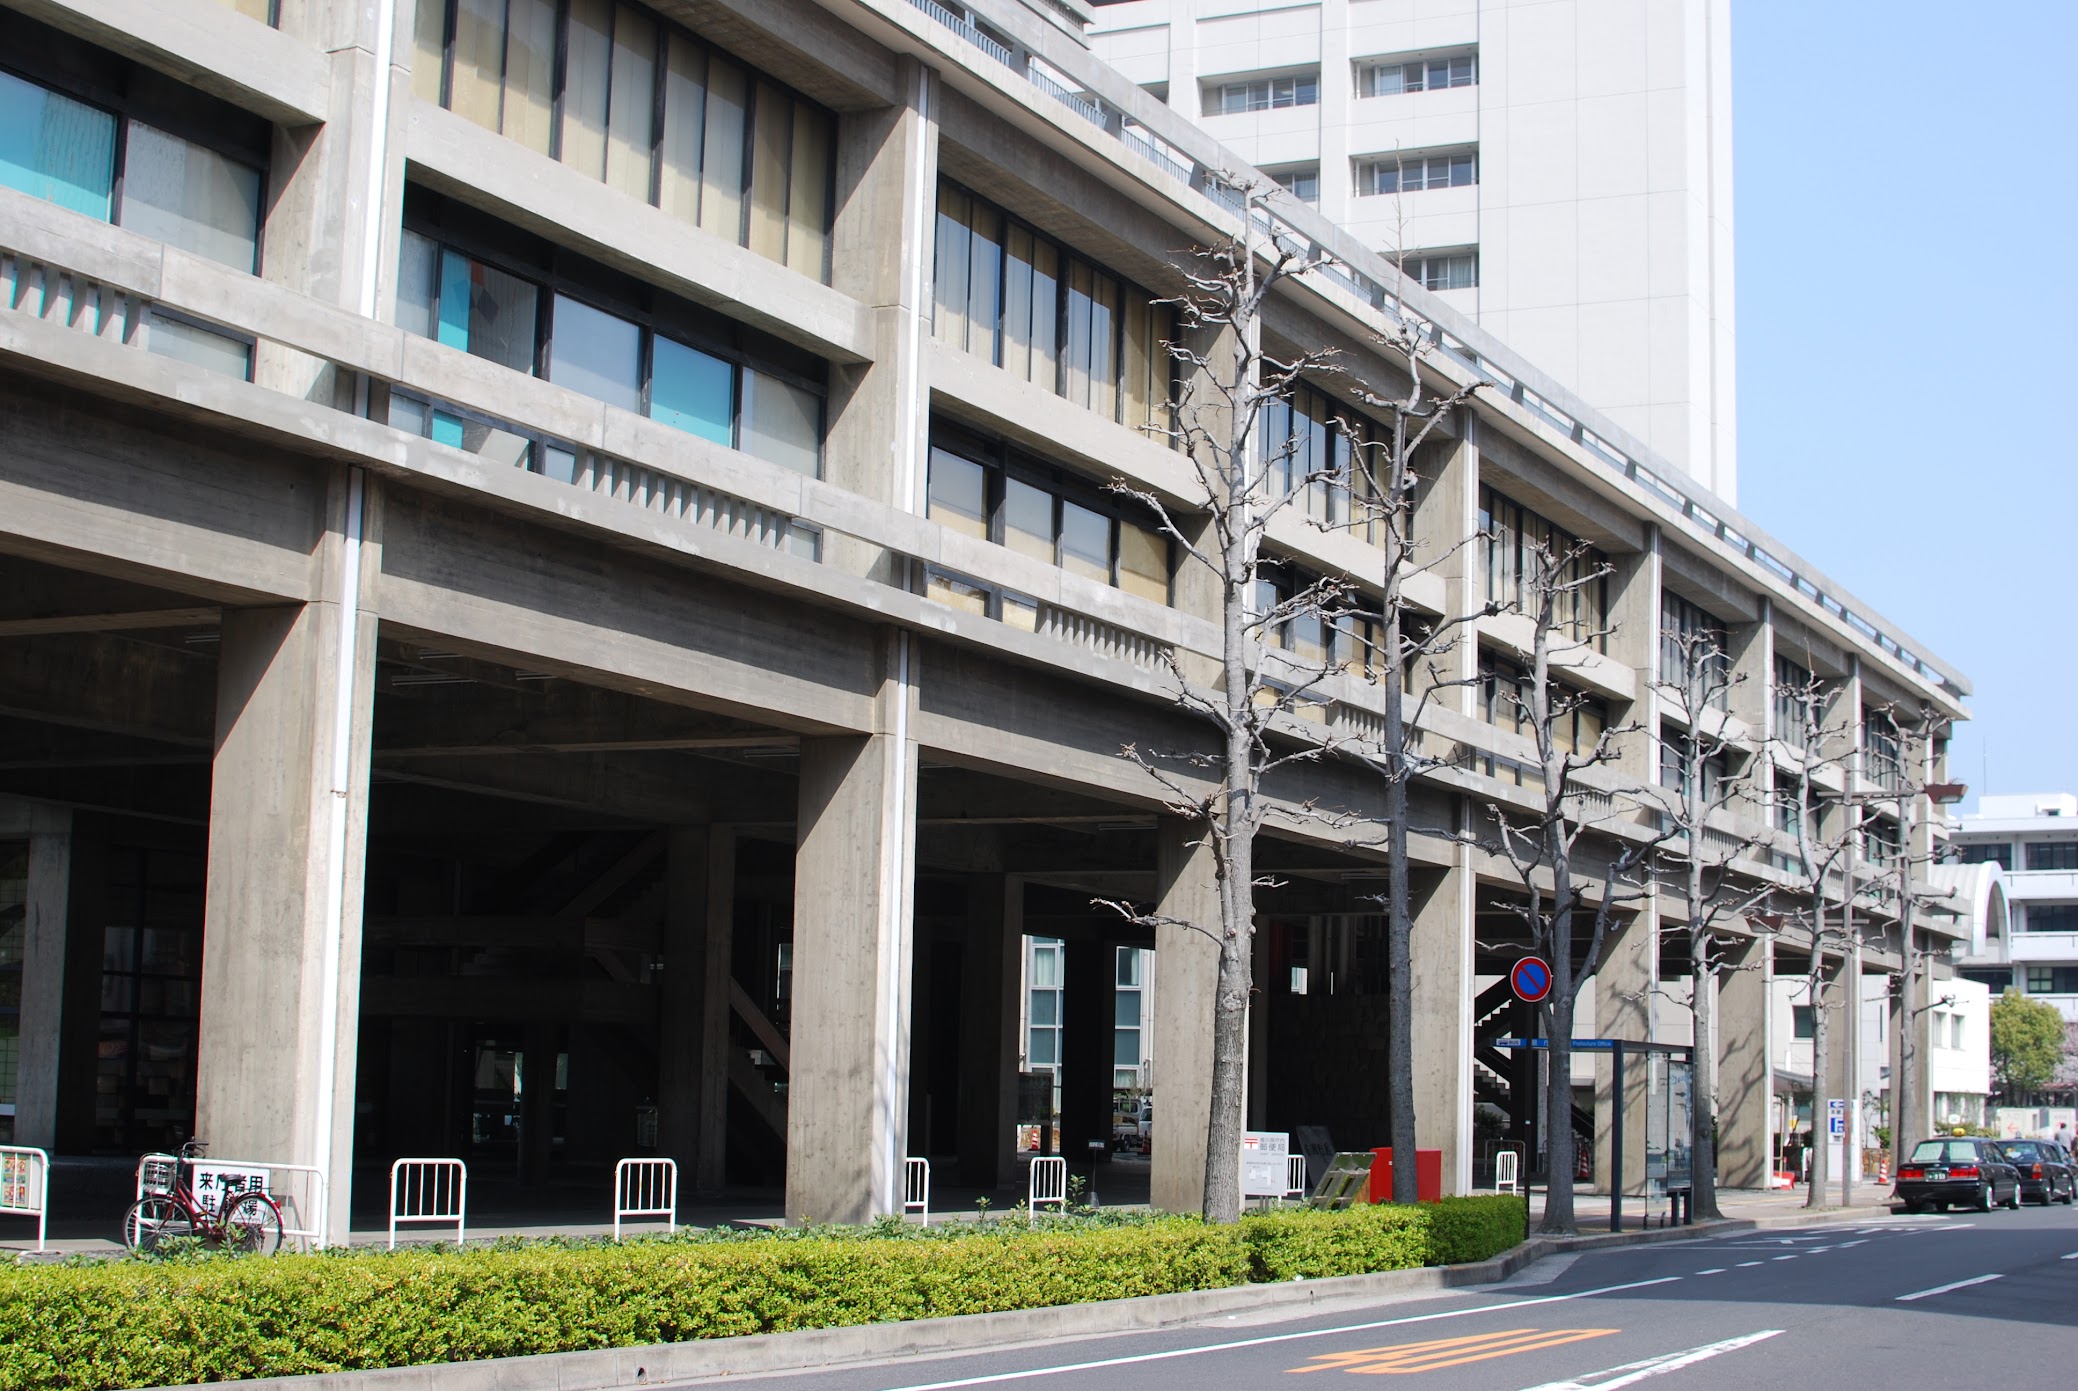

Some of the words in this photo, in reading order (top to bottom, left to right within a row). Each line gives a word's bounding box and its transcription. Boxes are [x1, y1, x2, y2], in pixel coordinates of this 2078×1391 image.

[1260, 1143, 1285, 1151] 郵便局
[202, 1195, 258, 1216] 駐場
